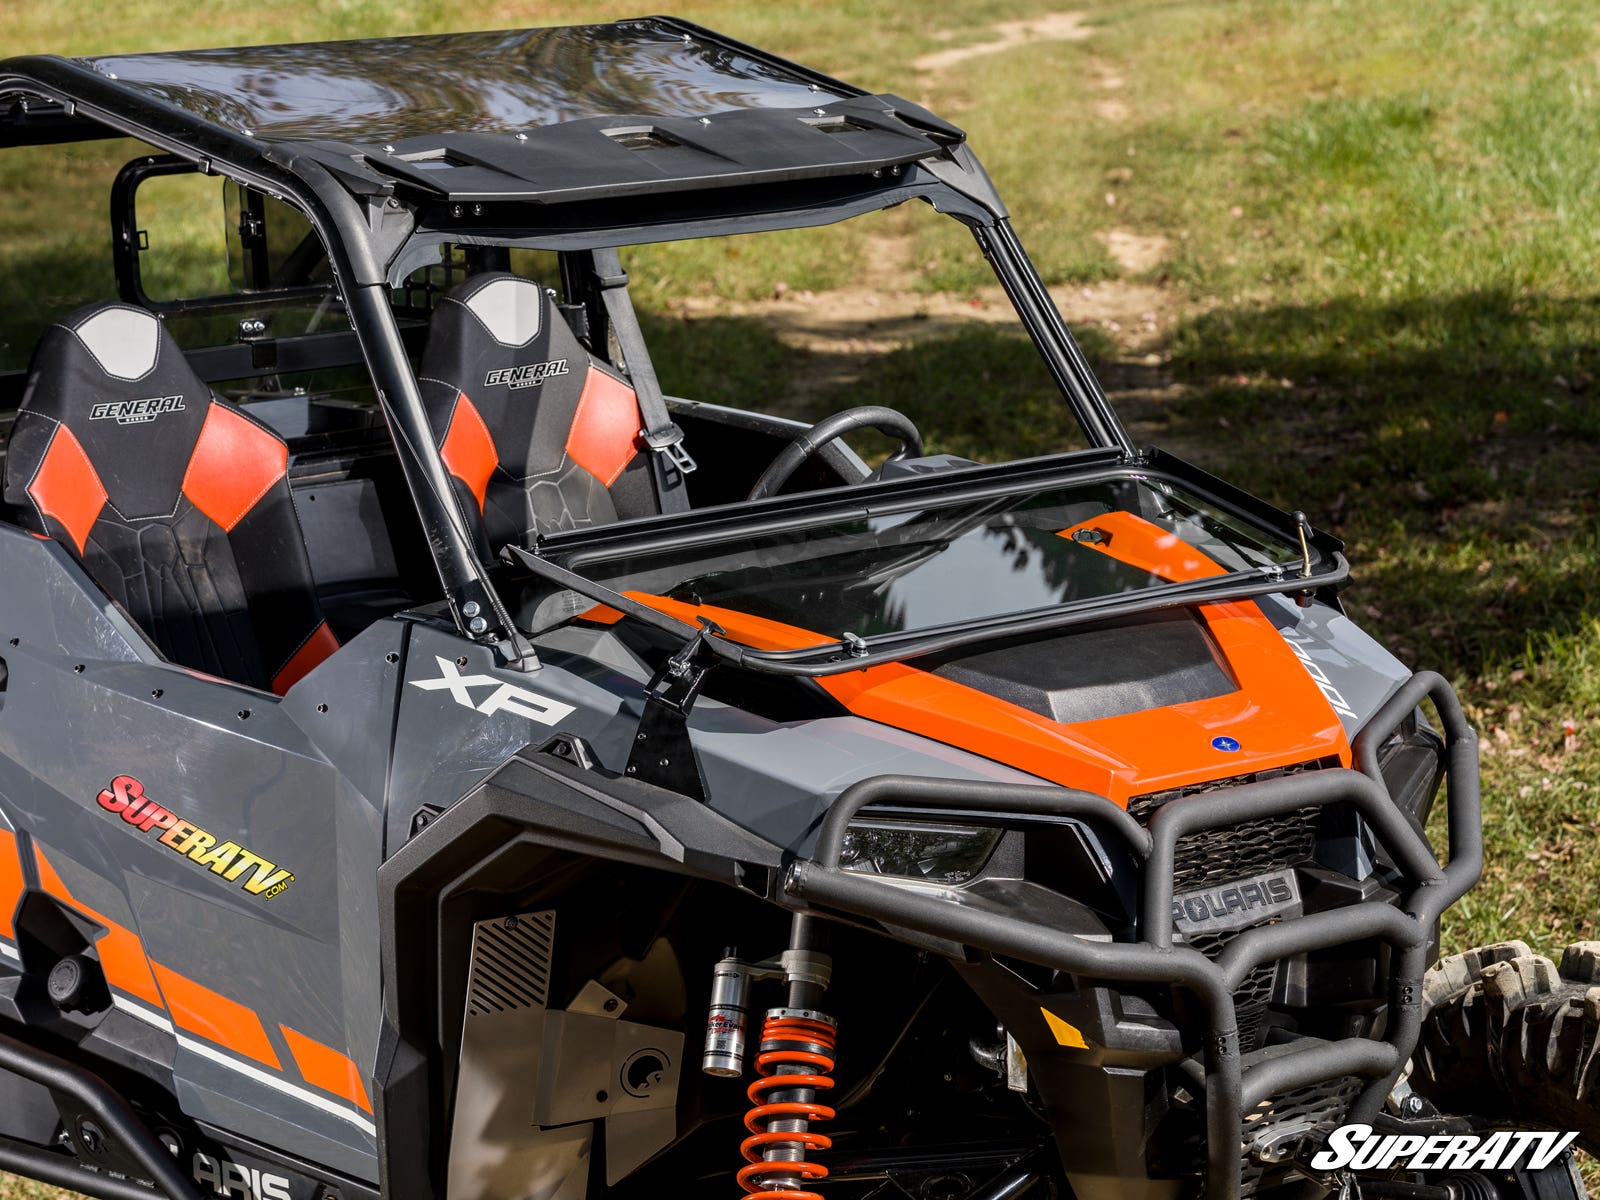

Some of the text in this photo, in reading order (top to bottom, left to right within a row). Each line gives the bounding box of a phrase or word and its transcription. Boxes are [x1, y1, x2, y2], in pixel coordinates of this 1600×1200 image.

[484, 359, 569, 387] GENERAL
[89, 395, 185, 420] GENERAL
[408, 655, 577, 727] XP
[190, 1151, 291, 1200] ARIS
